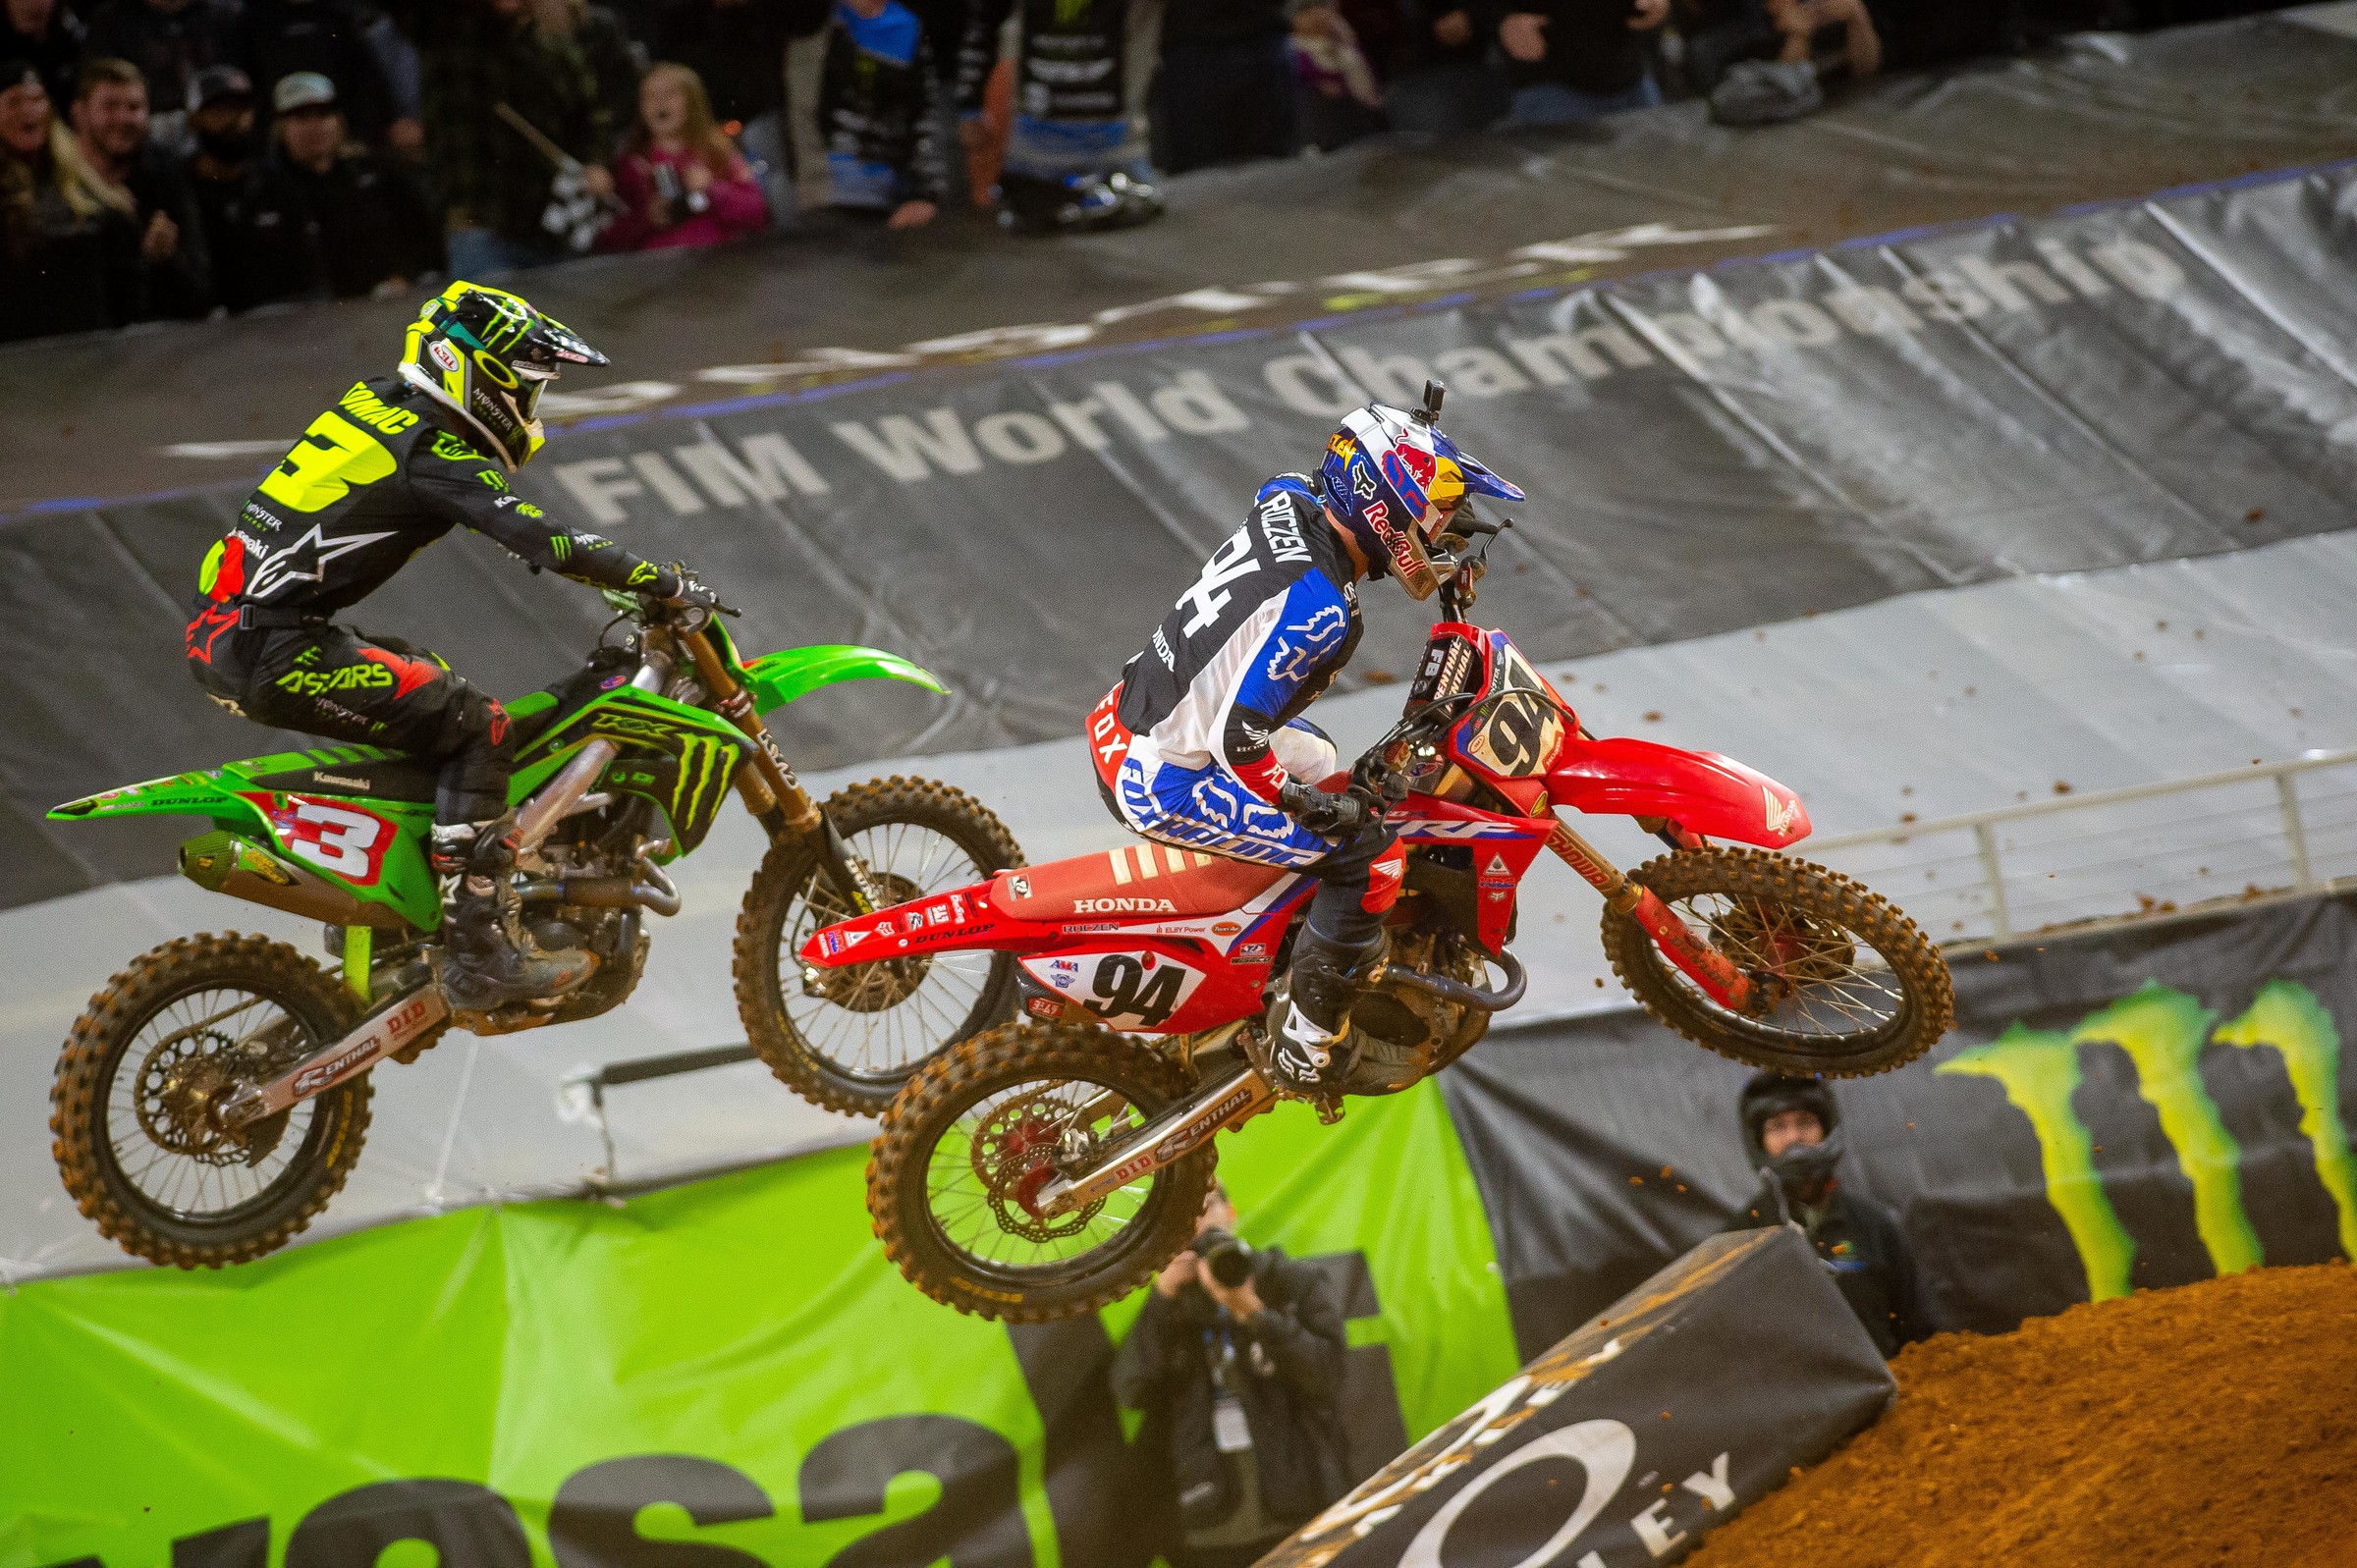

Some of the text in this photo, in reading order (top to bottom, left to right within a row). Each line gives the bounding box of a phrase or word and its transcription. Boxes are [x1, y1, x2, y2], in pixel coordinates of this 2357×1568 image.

[256, 409, 398, 513] 3
[552, 433, 832, 528] FIM
[833, 371, 1250, 483] World
[1445, 647, 1472, 714] RNTHAL
[1094, 691, 1128, 764] FOX
[1489, 654, 1558, 778] 94
[151, 796, 229, 806] DUNLOP
[1778, 799, 1796, 837] HONDA
[292, 804, 381, 878] 3
[1073, 897, 1178, 914] HONDA
[915, 922, 996, 944] DUNLOP
[1049, 959, 1079, 972] AMA
[1082, 953, 1186, 1027] 94
[386, 1000, 426, 1033] DID
[1115, 1155, 1152, 1179] DID
